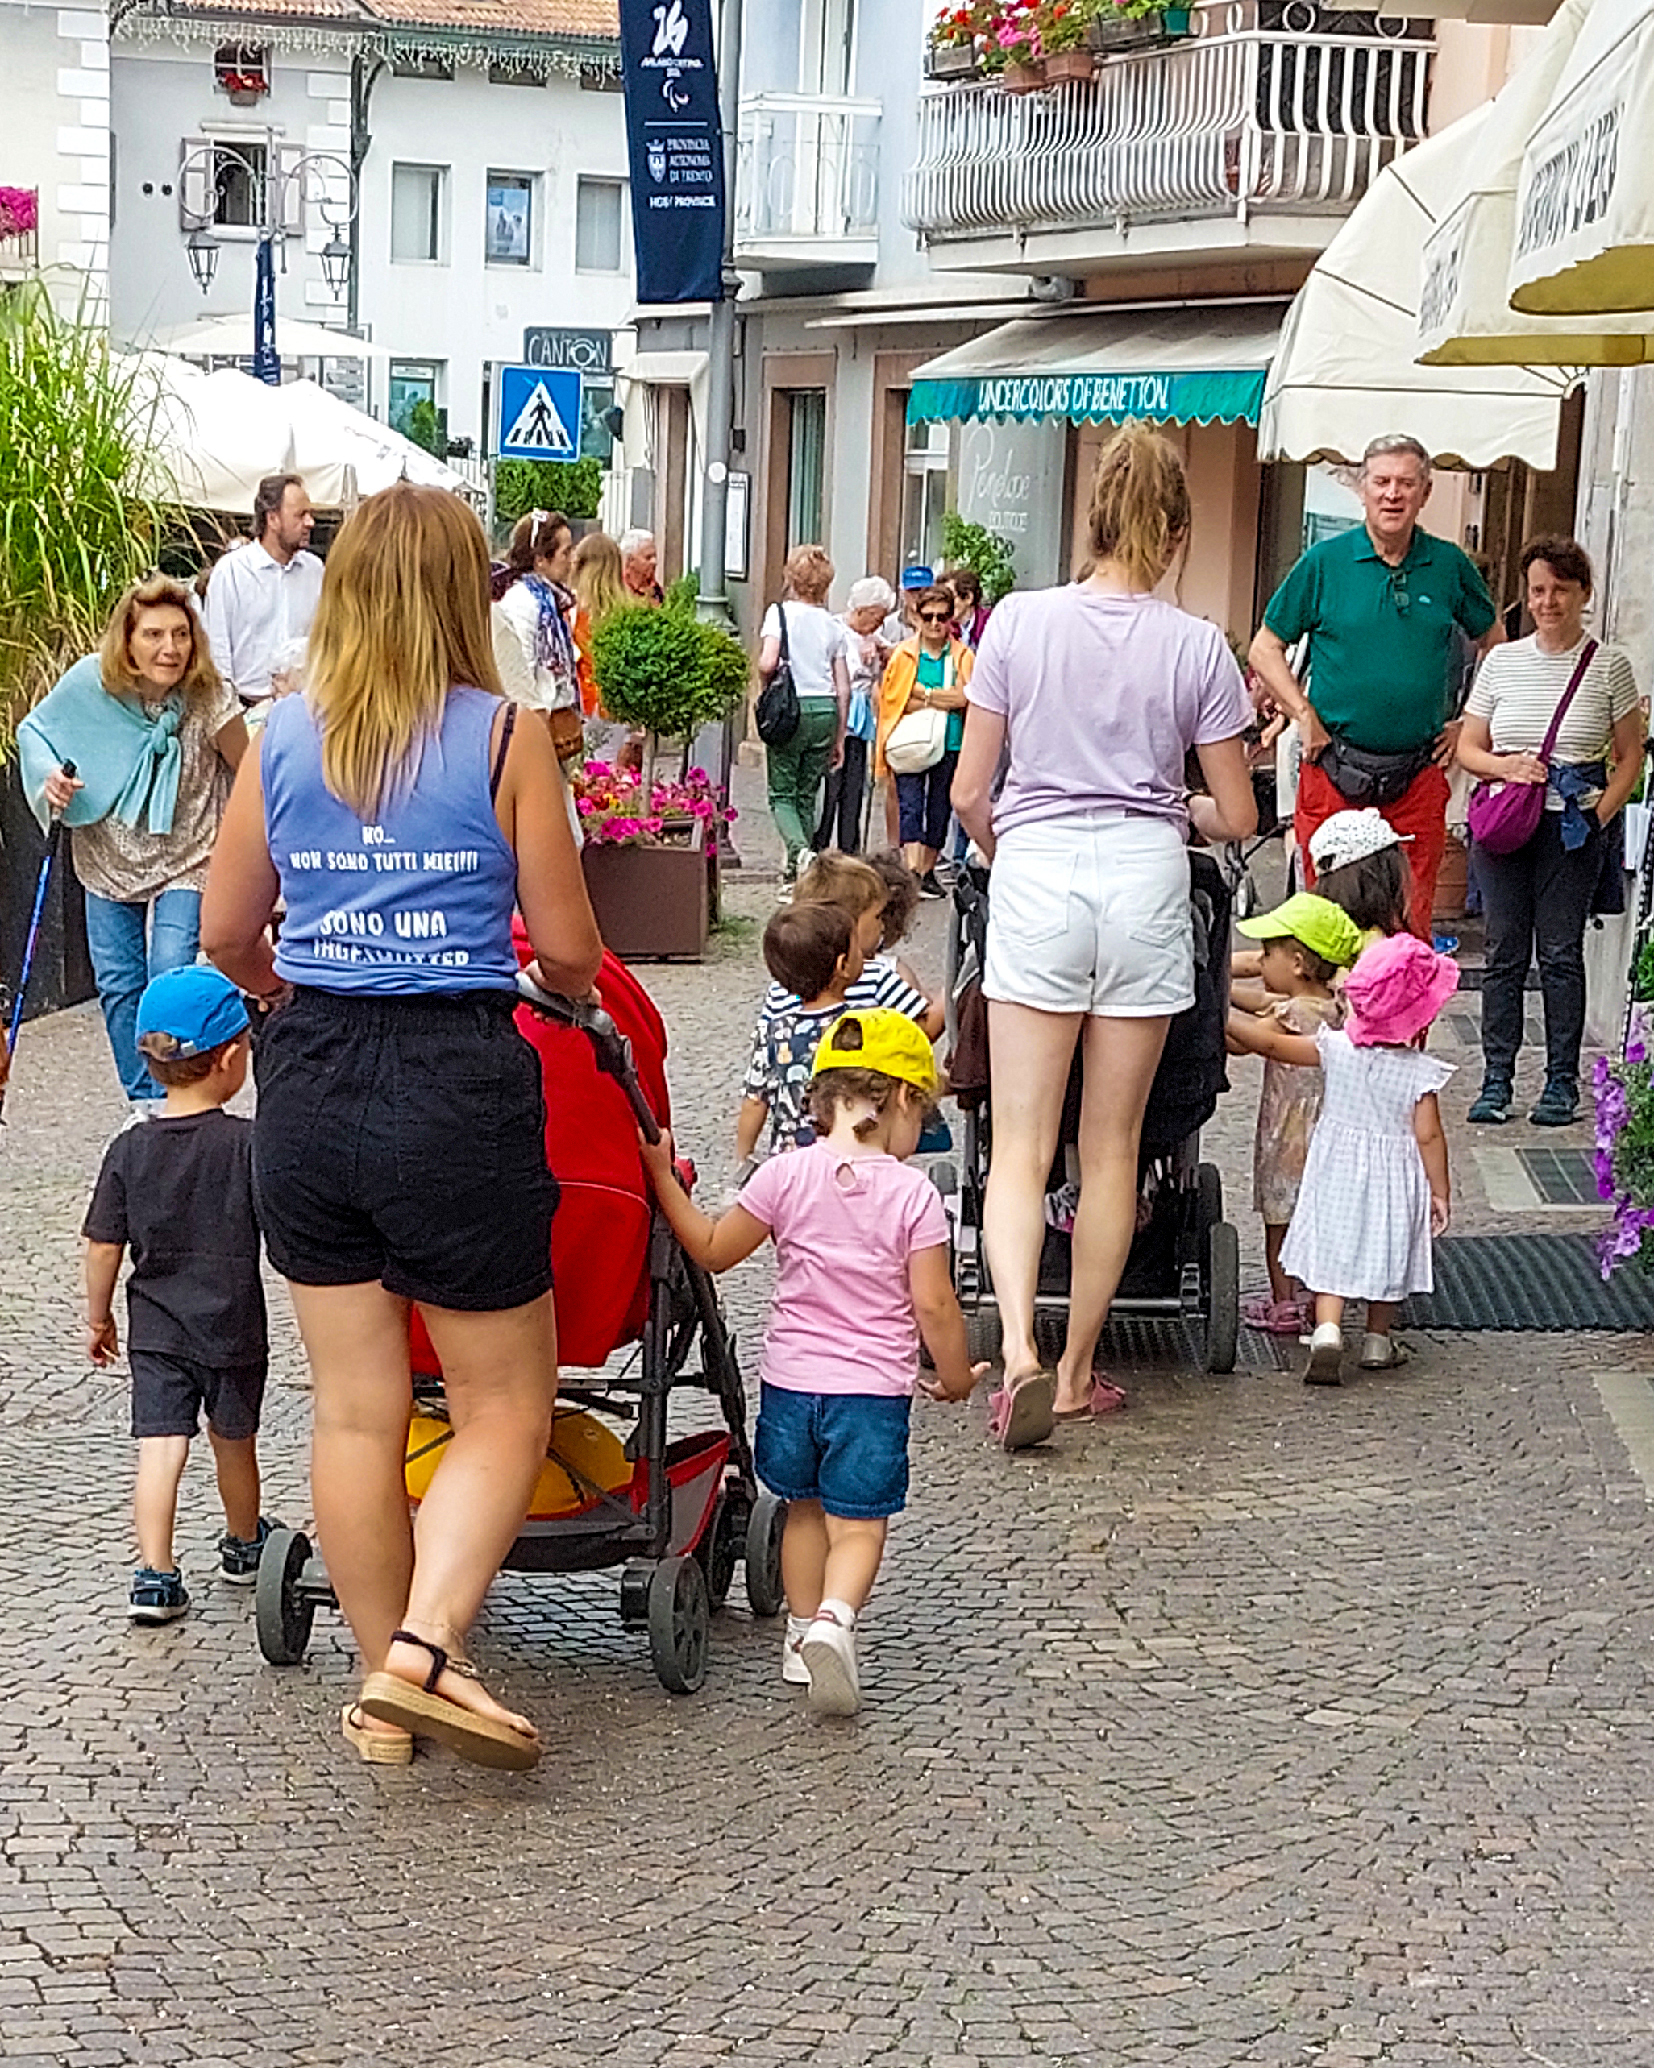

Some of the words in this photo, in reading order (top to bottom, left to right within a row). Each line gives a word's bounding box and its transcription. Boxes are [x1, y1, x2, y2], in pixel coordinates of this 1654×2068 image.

[667, 138, 710, 151] PROVINCIA
[670, 170, 680, 183] DI
[682, 169, 713, 182] TRENTO
[528, 336, 607, 367] CANTON
[979, 378, 1071, 412] UNDERCOLORS
[1072, 377, 1092, 411] OF
[289, 851, 322, 870] NON
[328, 851, 369, 870] SONO
[372, 852, 418, 872] TUTTI
[320, 910, 384, 937] SONO
[394, 910, 448, 938] UNA
